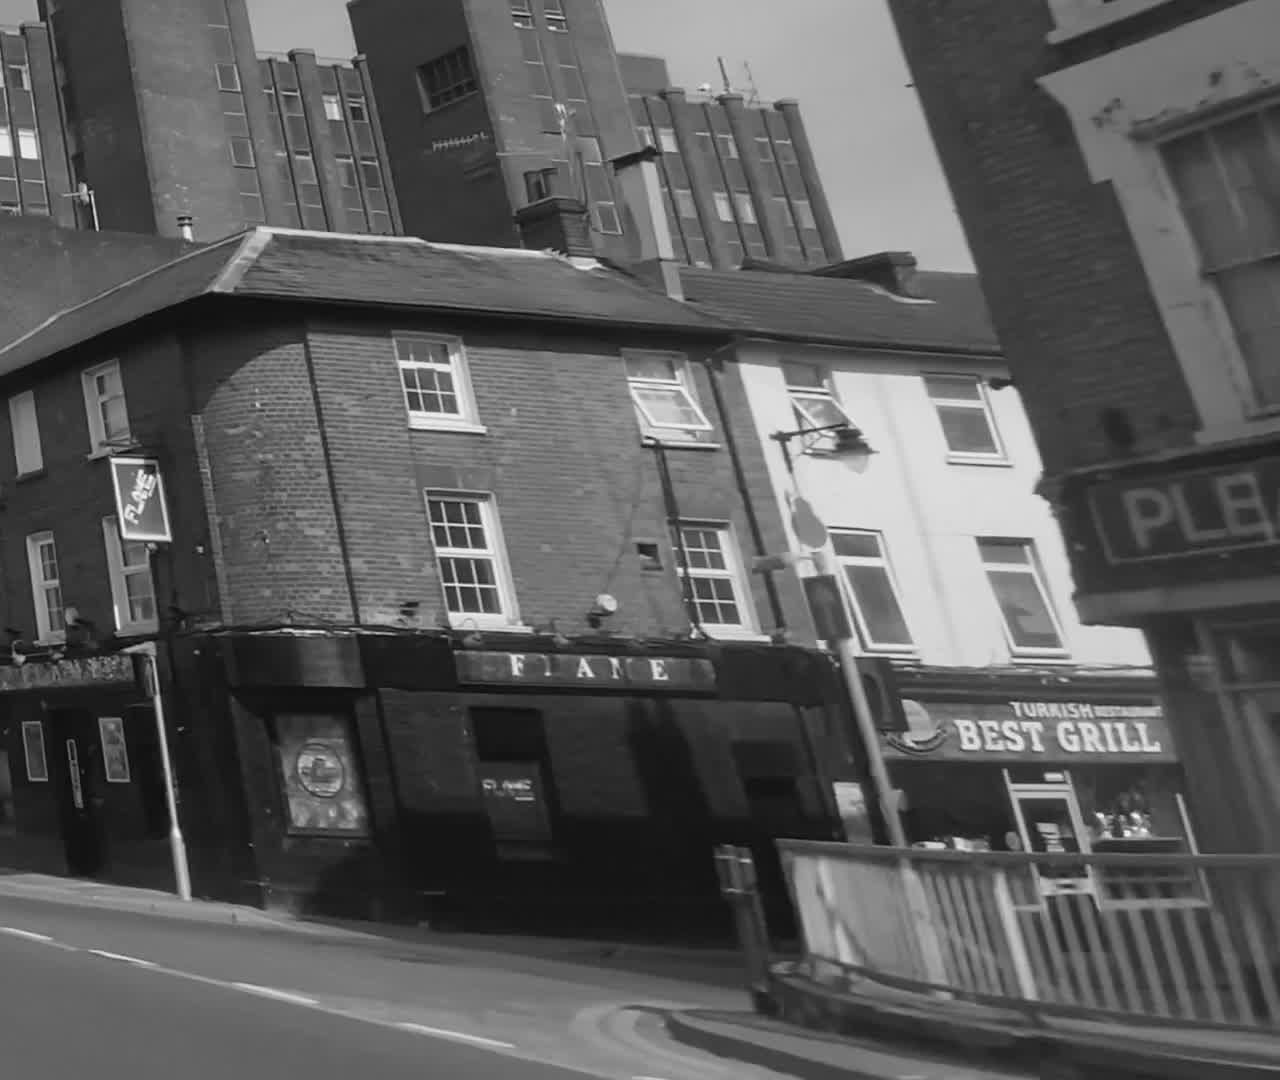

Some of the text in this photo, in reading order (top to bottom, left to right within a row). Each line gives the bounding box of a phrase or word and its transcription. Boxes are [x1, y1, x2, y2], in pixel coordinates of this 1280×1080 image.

[1009, 701, 1095, 718] TURKISH
[954, 719, 1162, 753] BEST GRILL
